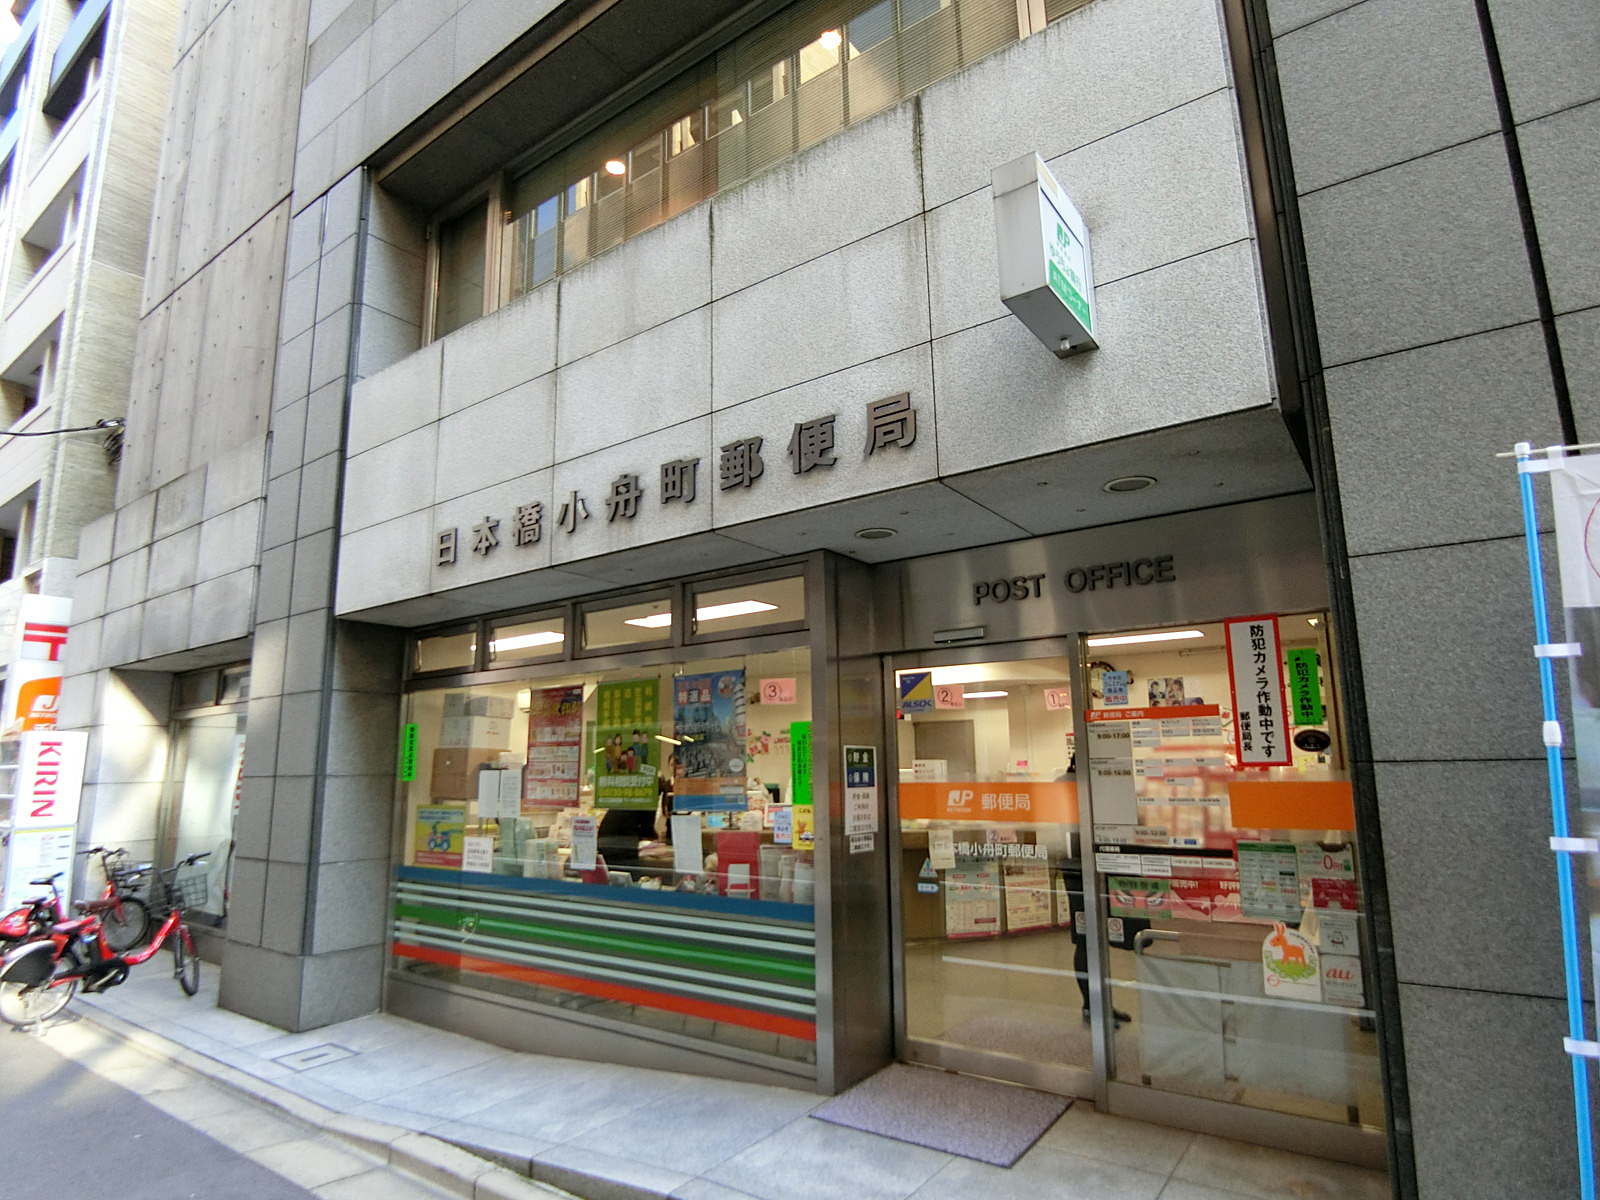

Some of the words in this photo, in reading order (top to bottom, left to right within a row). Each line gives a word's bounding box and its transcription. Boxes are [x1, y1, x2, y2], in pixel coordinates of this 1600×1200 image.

[436, 391, 917, 567] 日本橋小舟町郵便局
[973, 573, 1046, 606] POST
[1064, 555, 1176, 593] OFFICE
[901, 699, 933, 709] ALSOK
[1250, 624, 1276, 759] 防犯カメラ作動中です
[1295, 662, 1314, 718] 防犯カメラ作動中
[1240, 711, 1253, 752] 郵便局長
[30, 741, 63, 818] KIRIN
[947, 790, 974, 807] JP
[981, 793, 1031, 811] 郵便局
[1326, 968, 1354, 981] au
